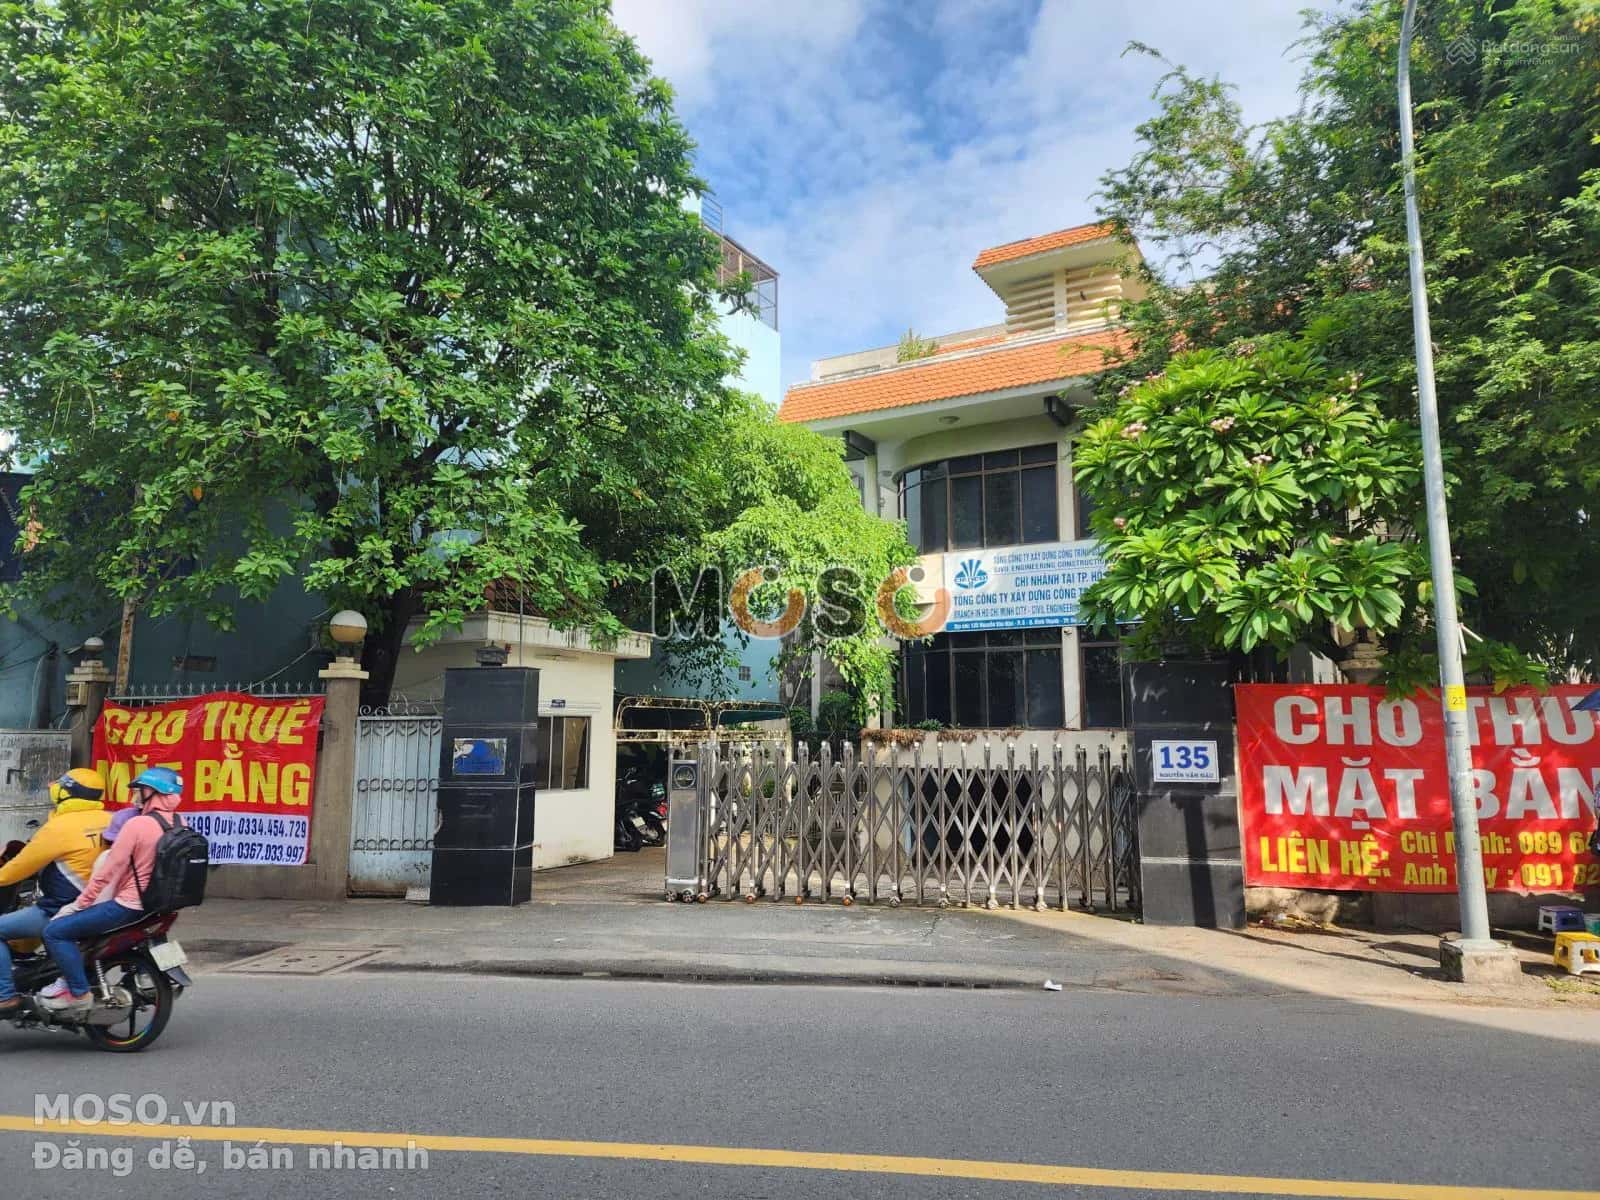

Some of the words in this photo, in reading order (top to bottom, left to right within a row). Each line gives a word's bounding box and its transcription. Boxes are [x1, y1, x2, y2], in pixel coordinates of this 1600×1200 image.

[104, 708, 188, 745] CHO
[203, 699, 311, 744] THUÊ
[1274, 695, 1423, 747] CHO
[194, 743, 311, 806] BẰNG
[1160, 746, 1210, 769] 135
[1263, 757, 1424, 829] MẶT
[238, 817, 306, 838] 0334.454.729
[1401, 830, 1438, 859] Chị
[1518, 831, 1562, 854] 089
[237, 841, 304, 863] 0367.033.997
[1260, 830, 1330, 874] LIÊN
[1340, 833, 1391, 884] HỆ:
[1403, 863, 1447, 885] Anh
[1521, 863, 1564, 887] 091
